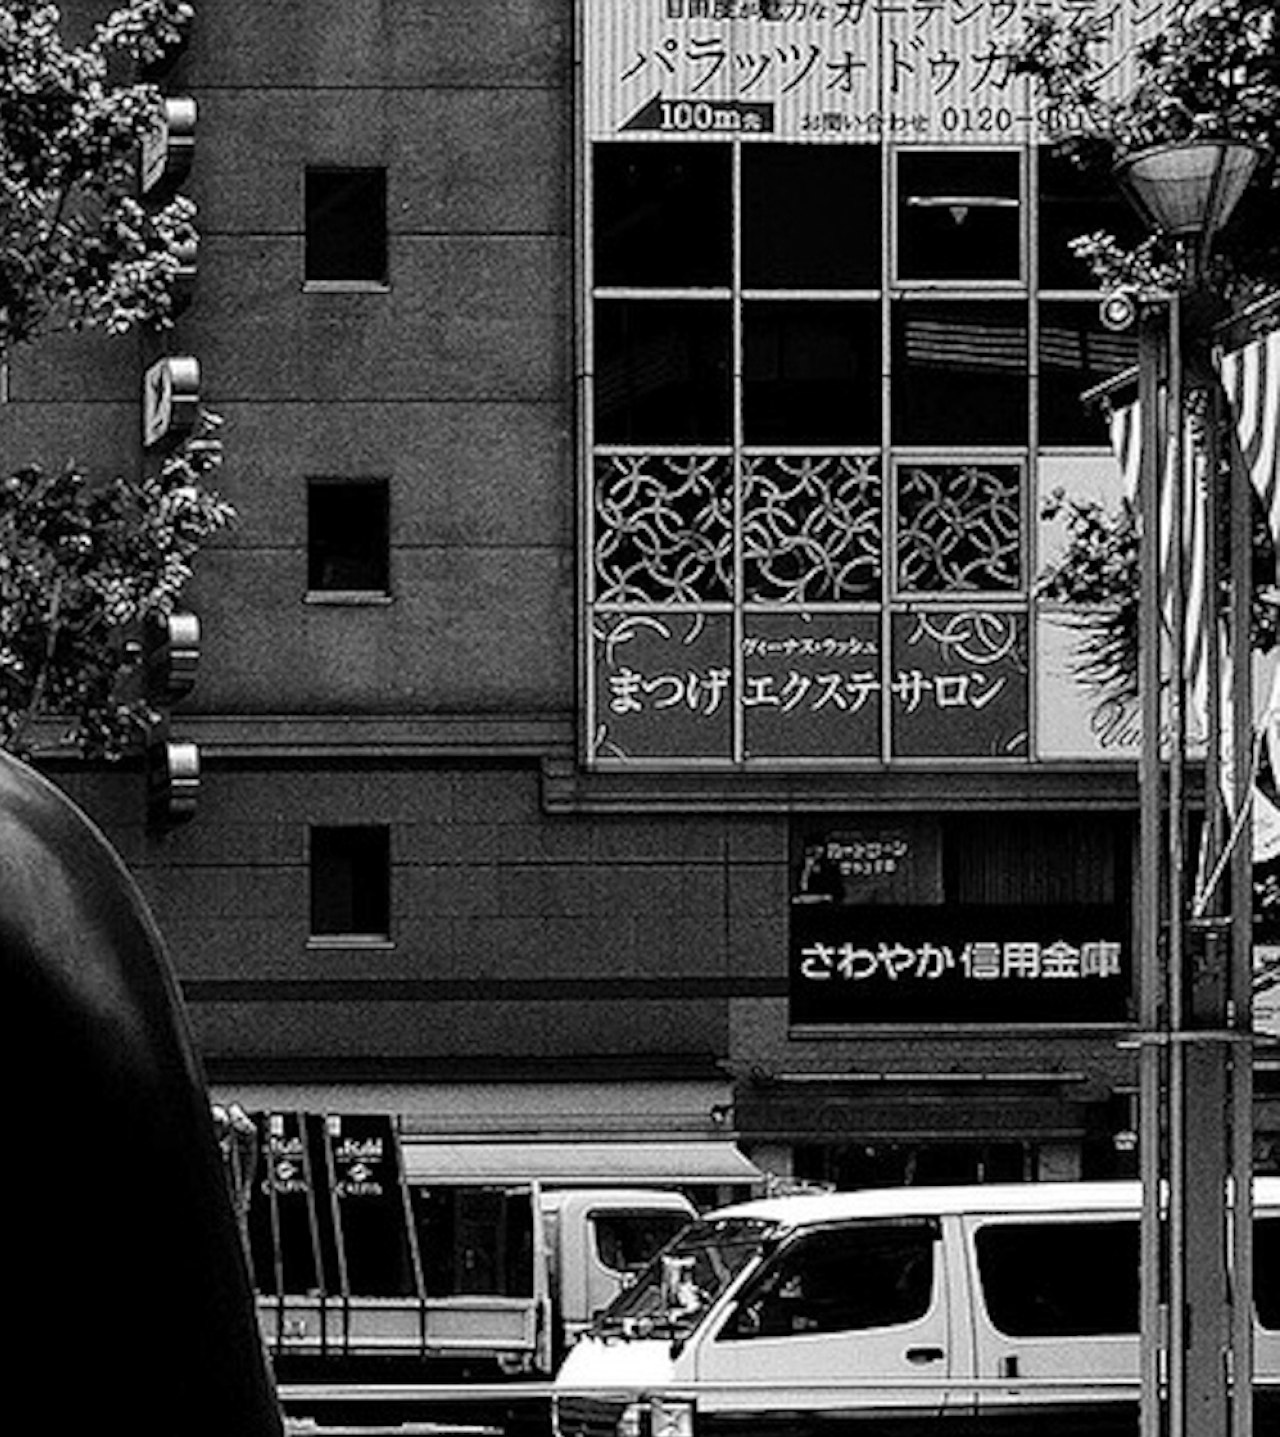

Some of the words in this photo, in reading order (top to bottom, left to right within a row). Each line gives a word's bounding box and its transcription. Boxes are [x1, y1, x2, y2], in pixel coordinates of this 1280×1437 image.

[799, 940, 1122, 981] さわやか信用金庫
